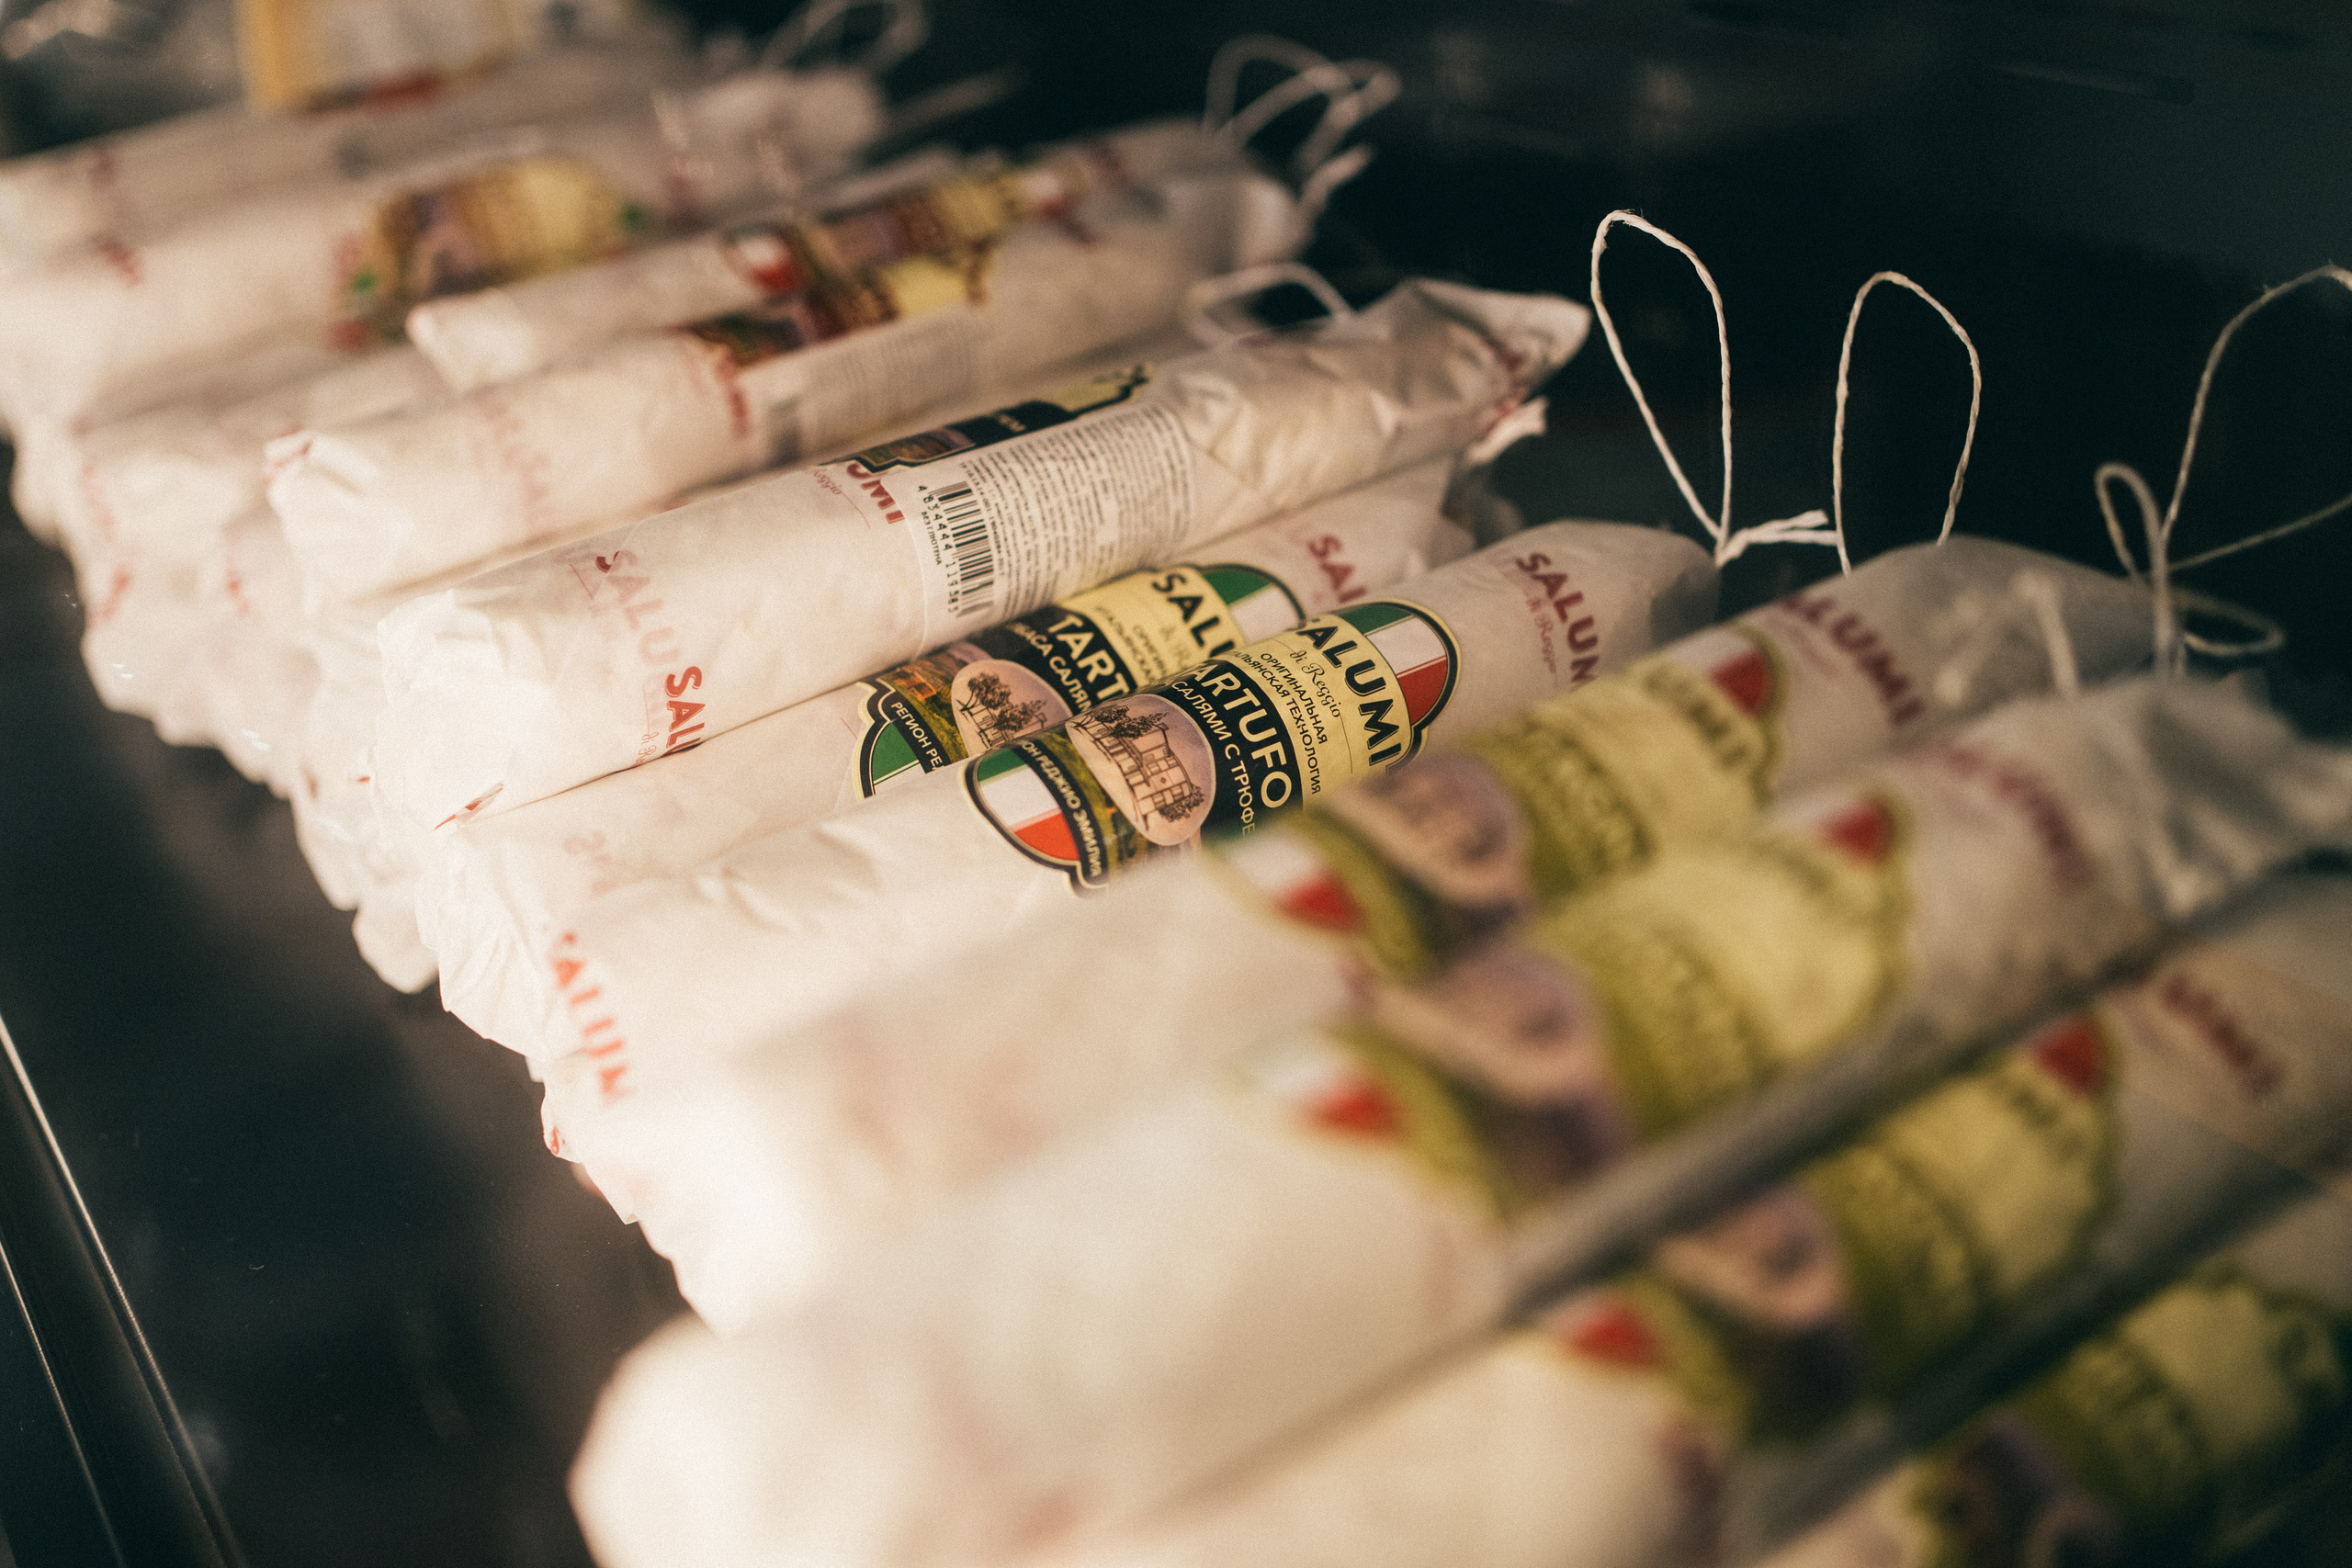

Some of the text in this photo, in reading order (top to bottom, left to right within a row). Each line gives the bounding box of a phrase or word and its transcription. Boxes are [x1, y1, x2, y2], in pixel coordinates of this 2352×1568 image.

[1047, 614, 1130, 701] TART
[1260, 652, 1329, 745] ОРИГИНАЛЬНАЯ
[1289, 650, 1342, 718] di Reggio
[1295, 619, 1402, 767] ALUMI
[890, 701, 945, 771] РЕГИОН РЕ
[1171, 681, 1233, 741] САЛЯМИ
[1286, 697, 1321, 795] ТЕХНОЛОГИЯ
[1035, 754, 1082, 810] РЕДЖИО
[1073, 808, 1102, 878] ЭМИЛИЯ
